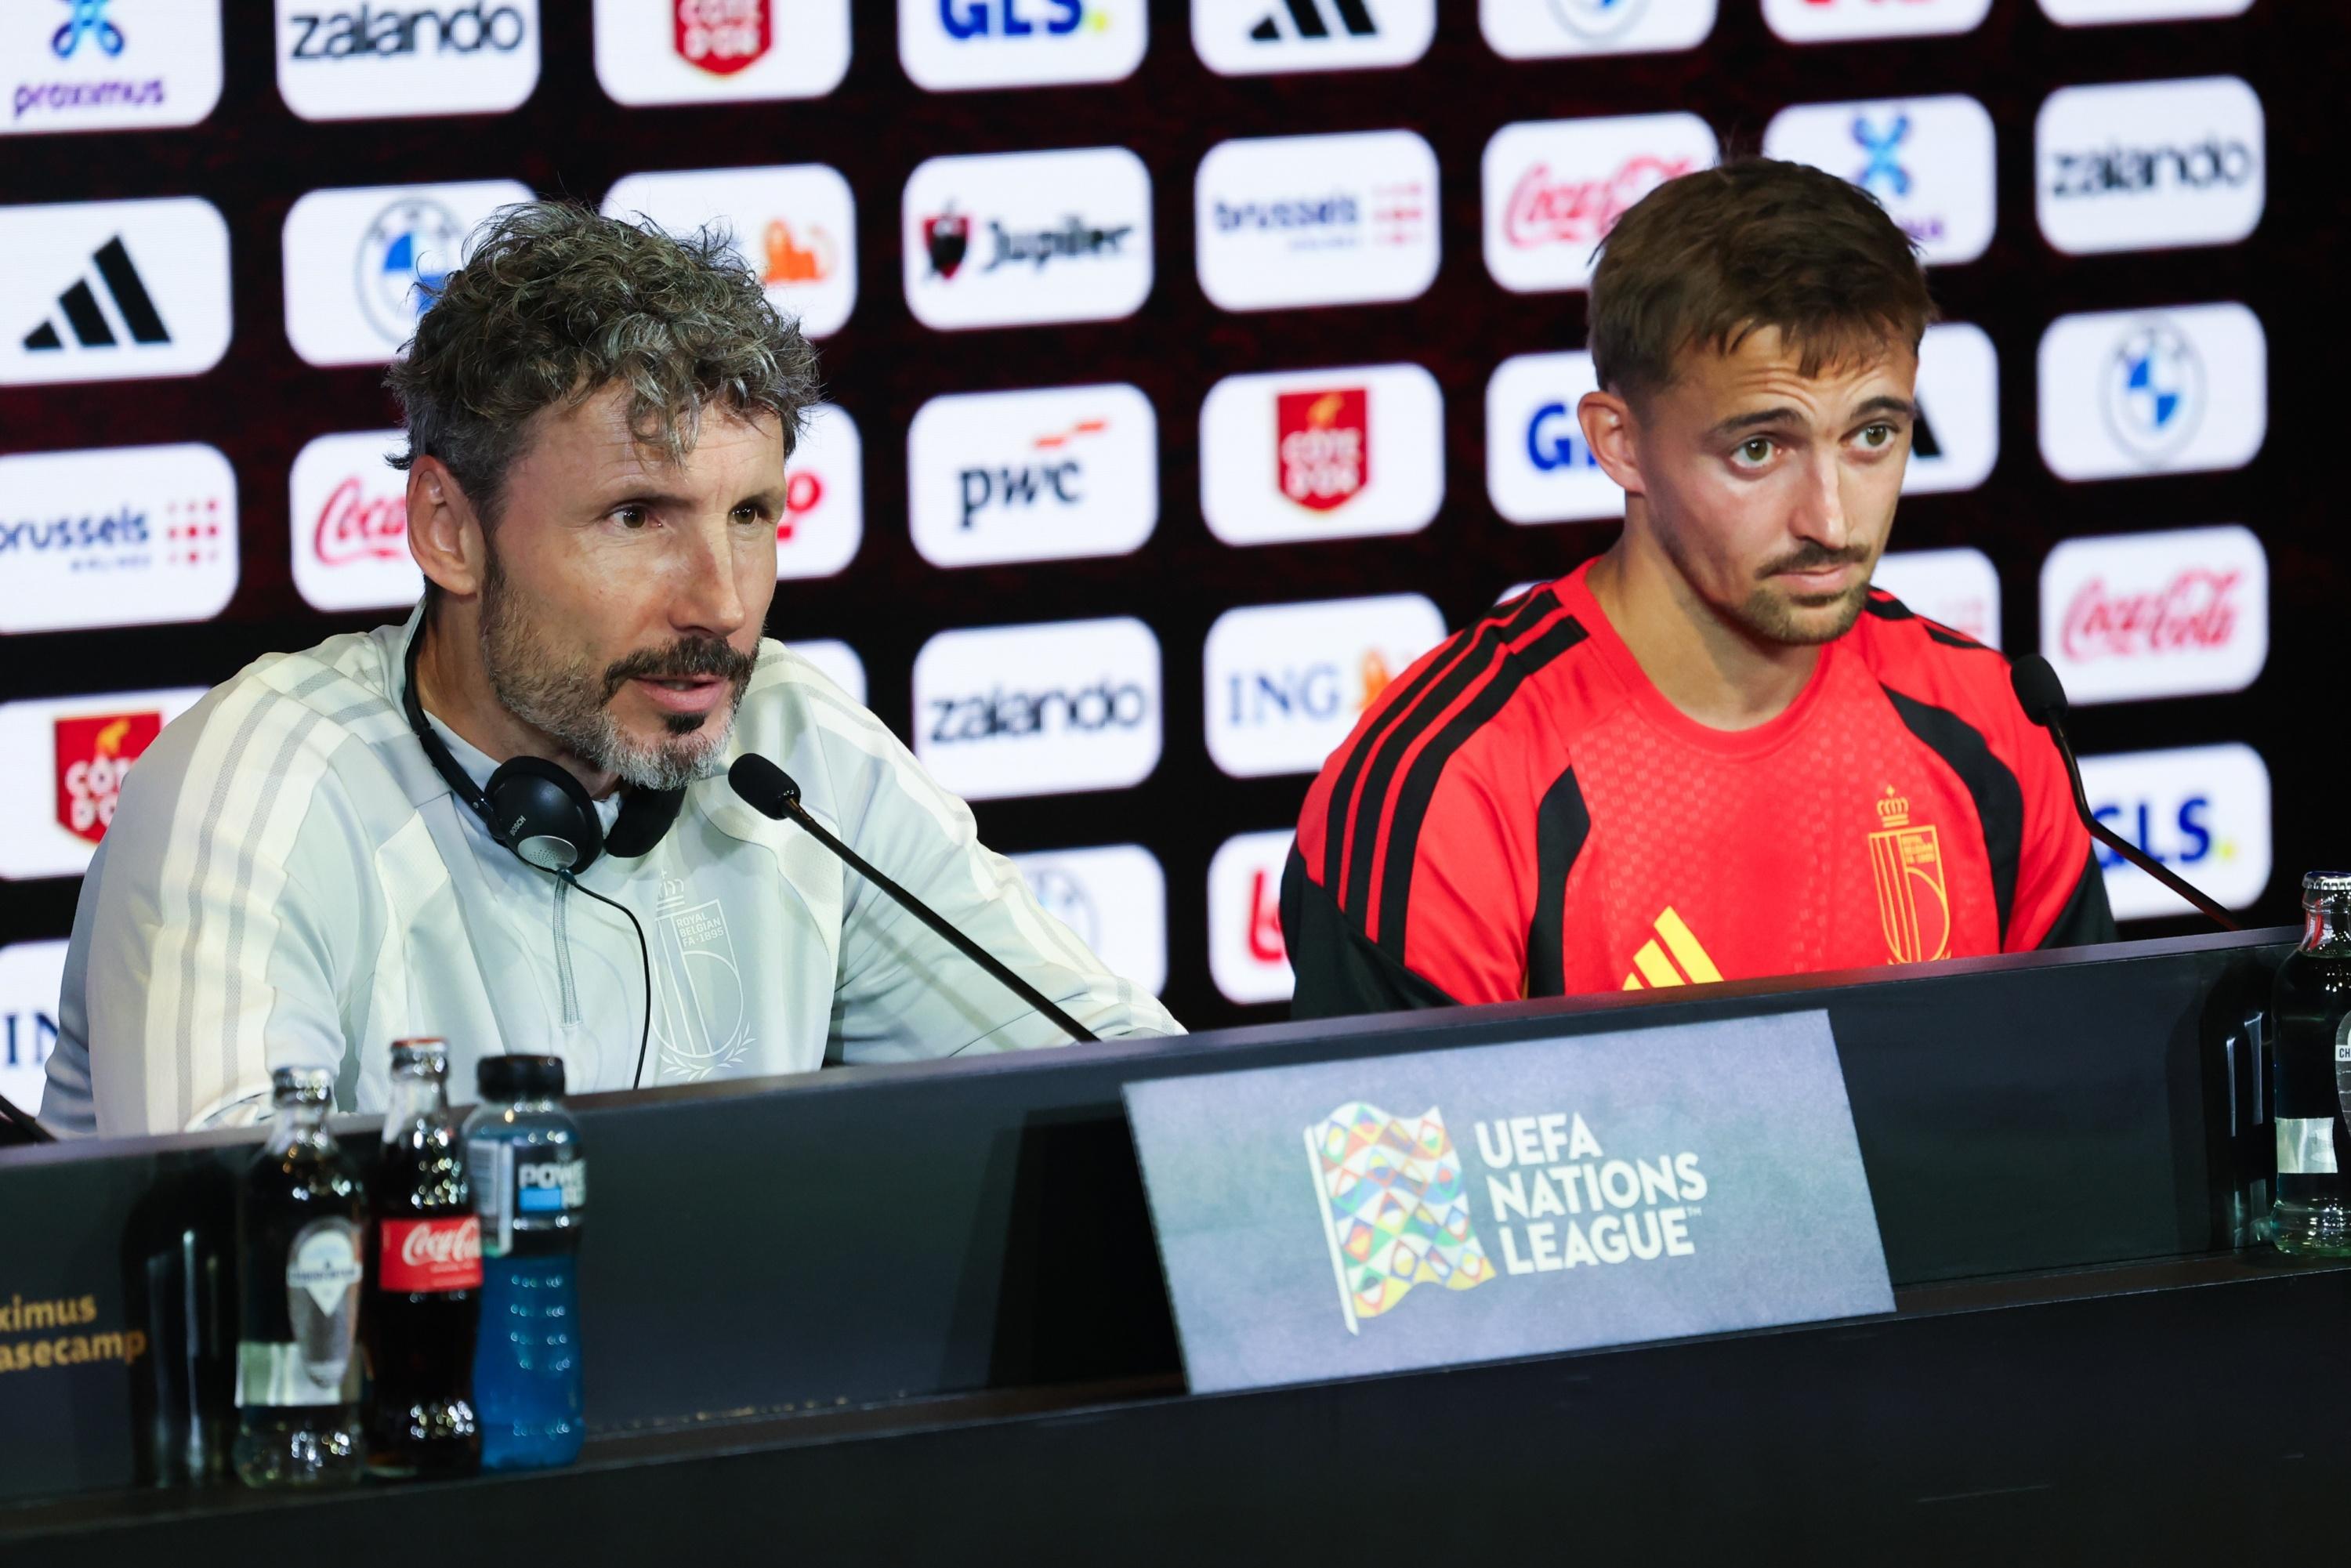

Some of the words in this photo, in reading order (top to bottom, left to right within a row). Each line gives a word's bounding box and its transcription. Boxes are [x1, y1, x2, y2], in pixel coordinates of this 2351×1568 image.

[292, 0, 523, 59] zalando
[14, 78, 163, 119] proximus
[2051, 129, 2251, 196] zalando
[962, 460, 1080, 528] pwc
[932, 680, 1145, 743] zalando
[1229, 663, 1342, 726] ING
[509, 815, 527, 836] BOSCH
[676, 911, 708, 928] ROYAL
[679, 918, 721, 937] BELGIAN
[1473, 1111, 1604, 1168] UEFA
[1486, 1152, 1708, 1222] NATIONS
[1498, 1207, 1696, 1275] LEAGUE
